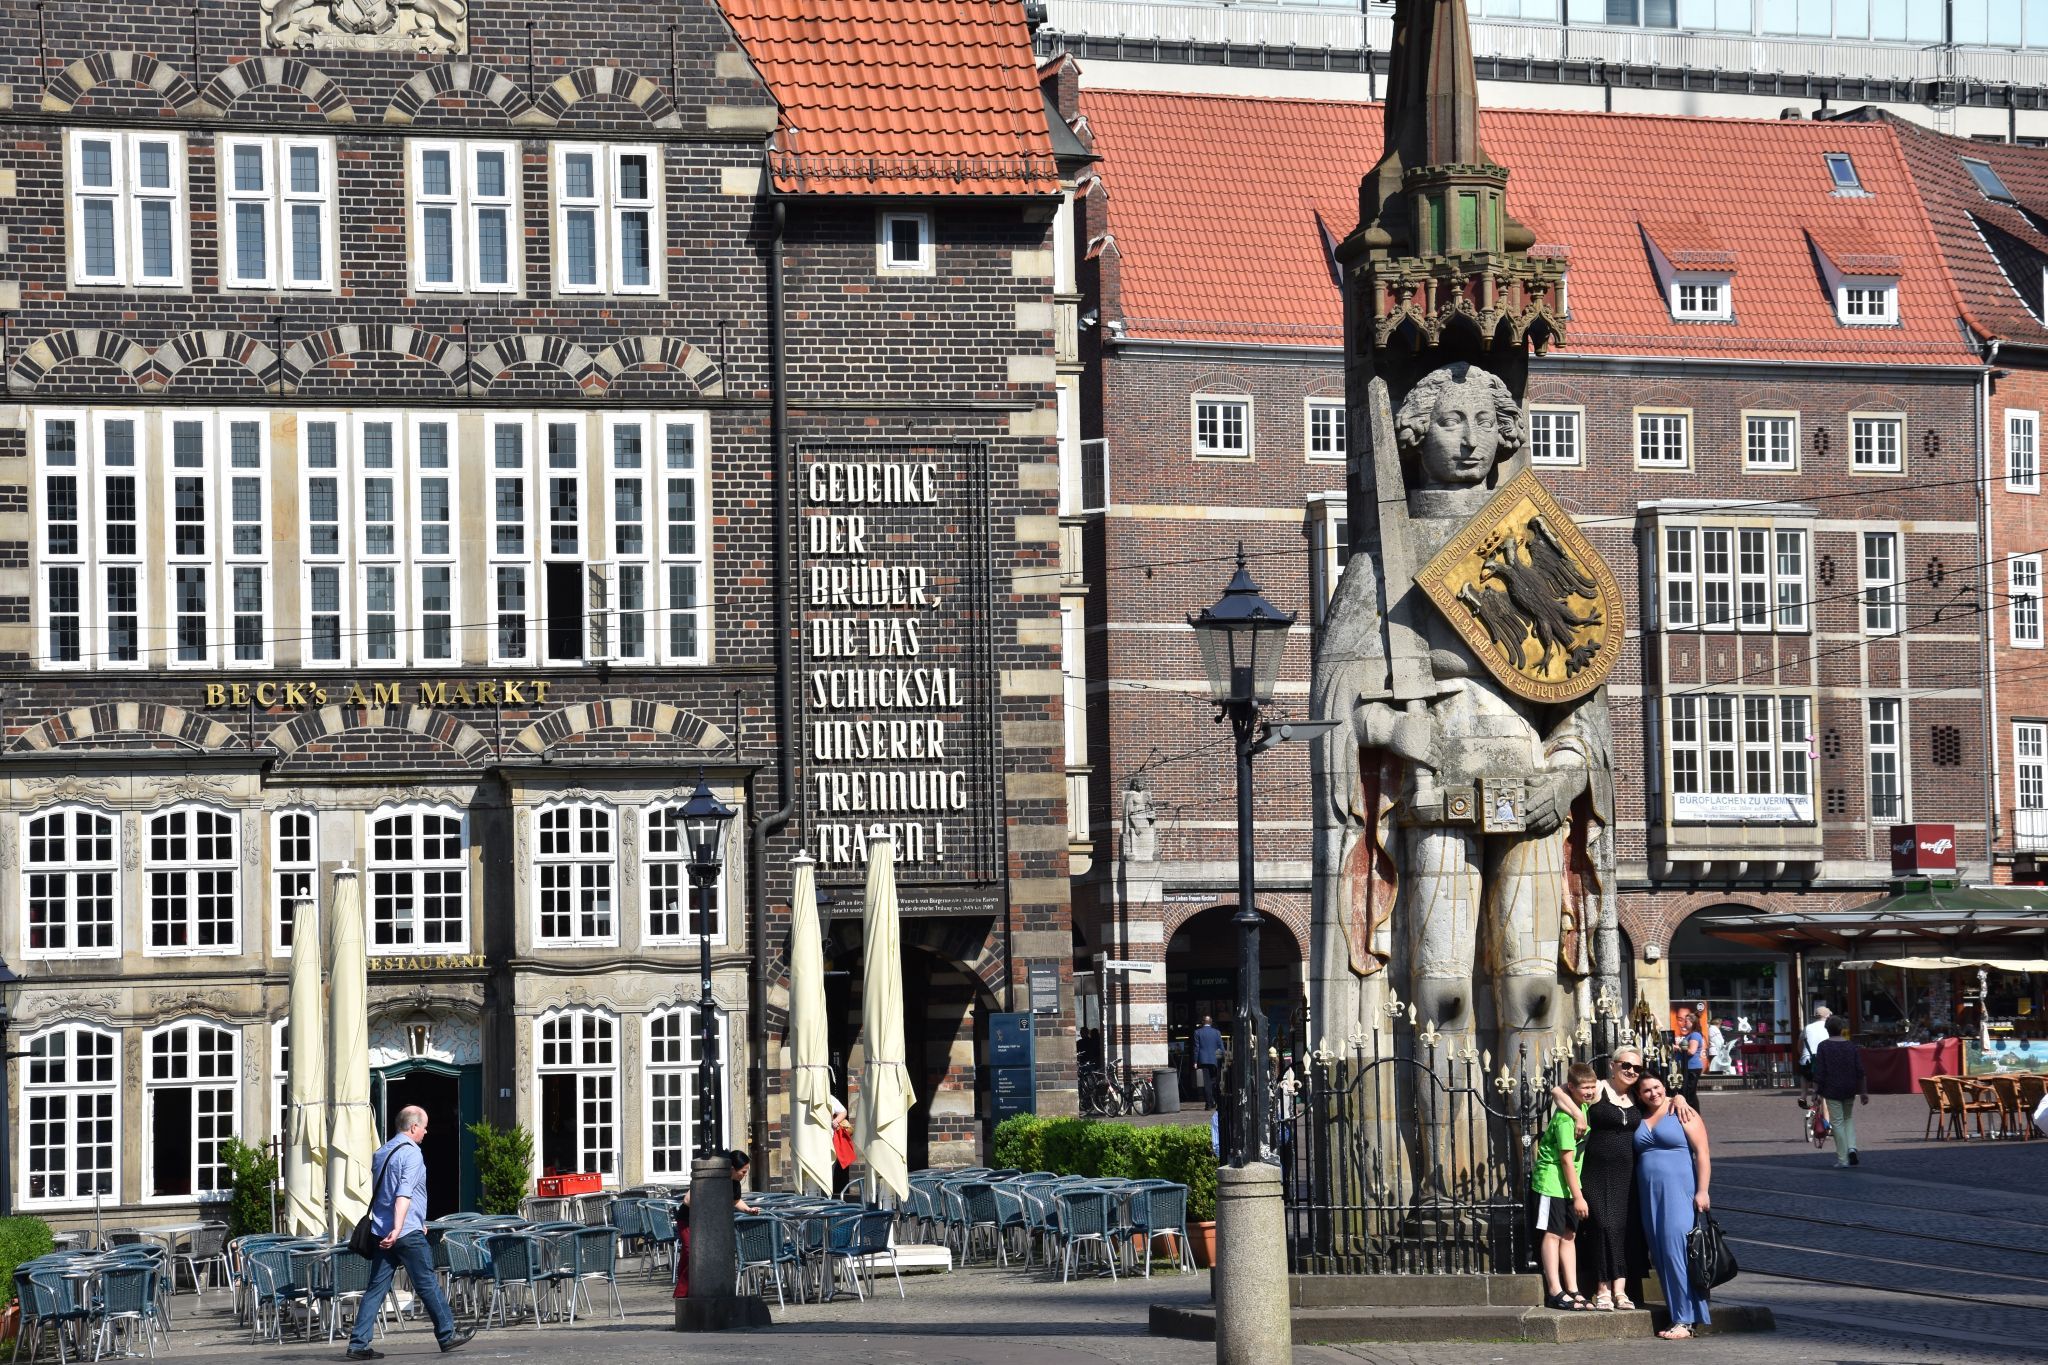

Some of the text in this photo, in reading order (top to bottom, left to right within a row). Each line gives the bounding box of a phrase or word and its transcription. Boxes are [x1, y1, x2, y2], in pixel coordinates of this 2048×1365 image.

[809, 463, 937, 502] GEDENKE
[810, 515, 865, 554] DER
[811, 559, 941, 608] BRÜDER,
[812, 617, 920, 657] DIE DAS
[347, 682, 401, 705] AM
[420, 681, 550, 705] MARKT
[813, 667, 963, 708] SCHICKSAL
[814, 720, 944, 760] UNSERER
[815, 771, 967, 811] TRENNUNG
[1749, 796, 1760, 805] ZU
[368, 955, 487, 970] ESTAURANT
